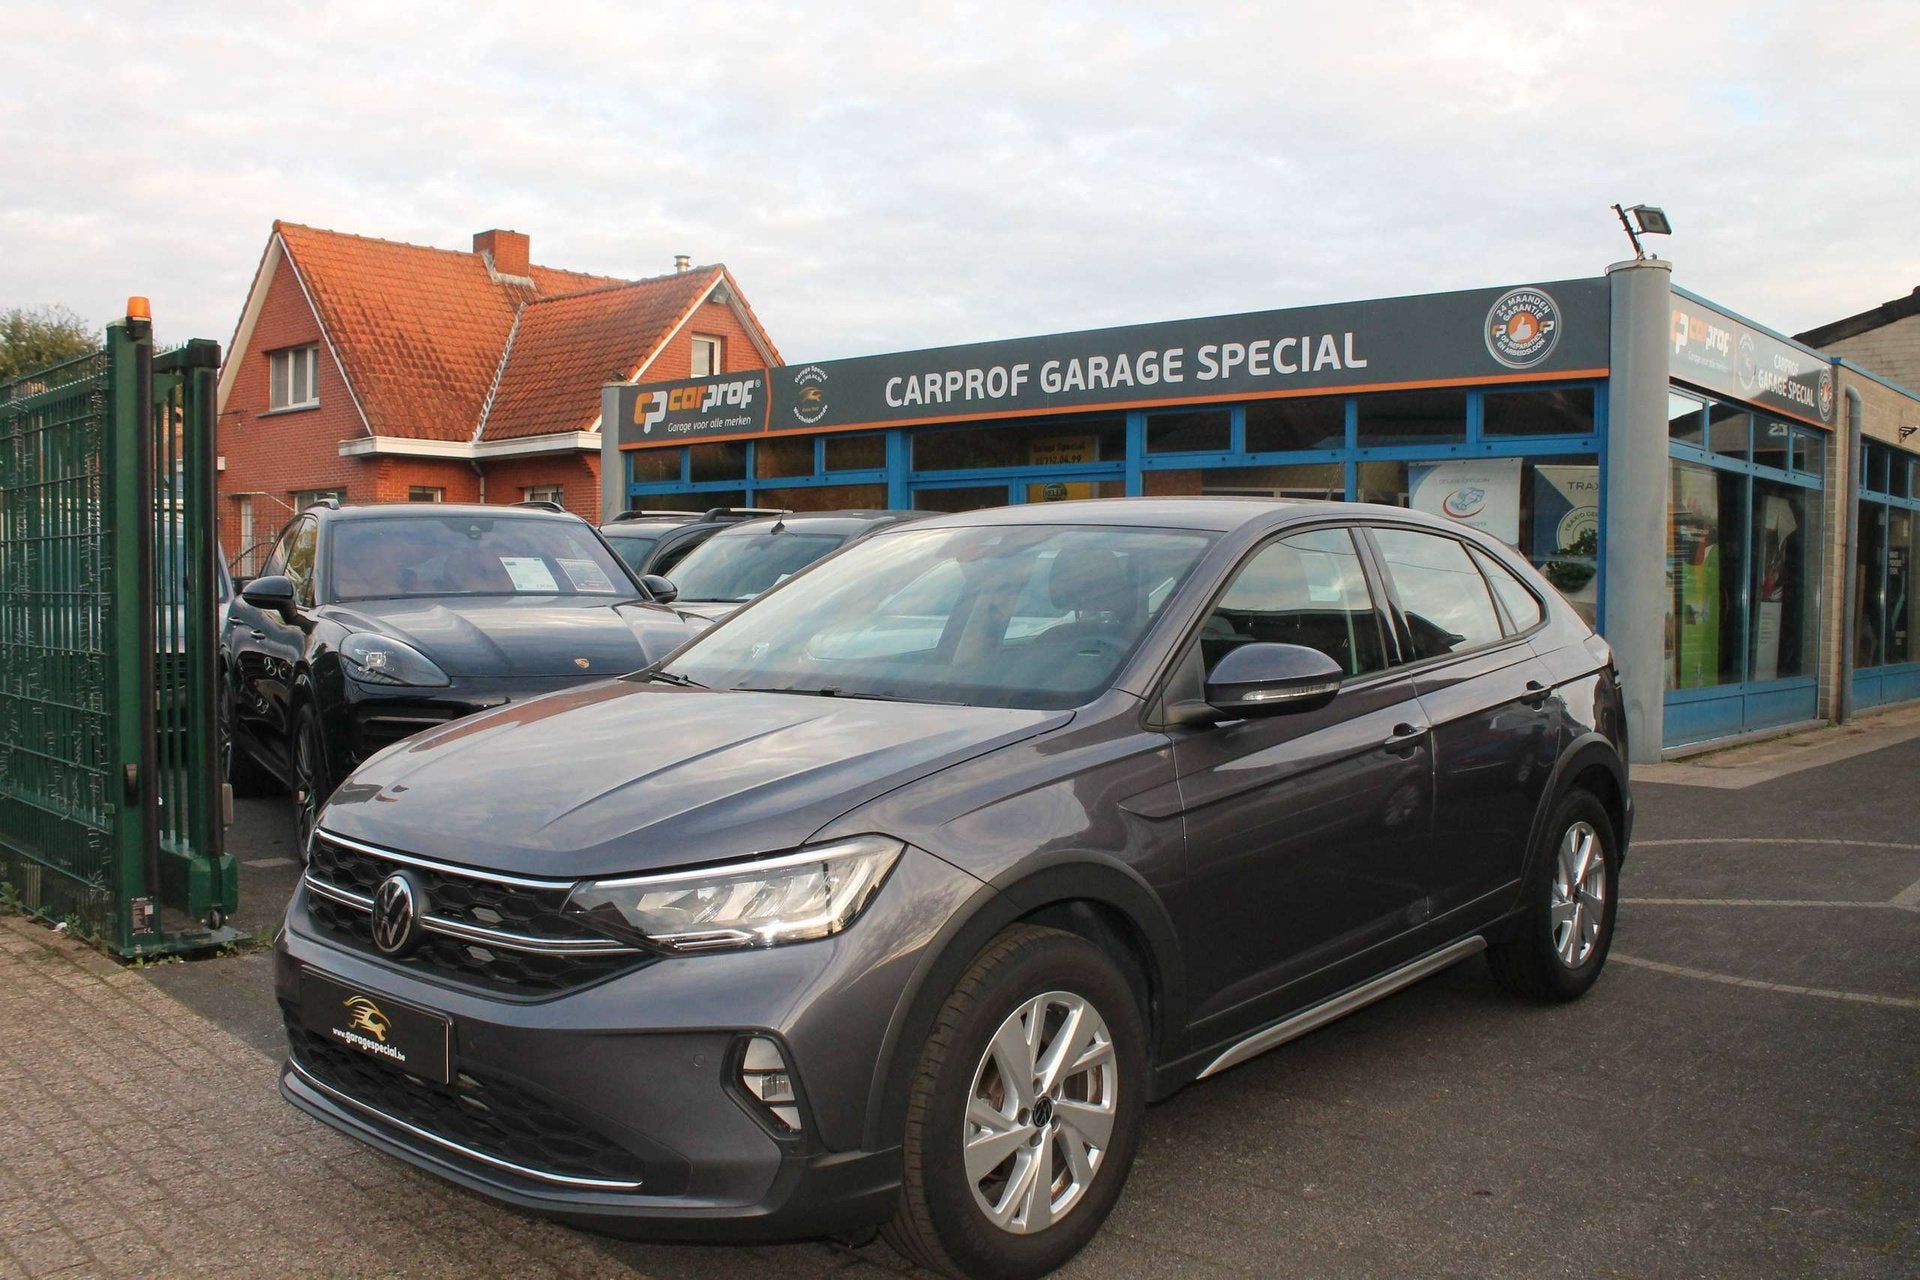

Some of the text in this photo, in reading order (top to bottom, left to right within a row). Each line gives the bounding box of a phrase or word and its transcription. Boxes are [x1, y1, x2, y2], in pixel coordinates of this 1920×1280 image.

[1496, 294, 1551, 317] 24 MAANDEN
[1503, 303, 1544, 322] GARANTIE
[885, 331, 1368, 408] CARPROF GARAGE SPECIAL
[1758, 369, 1788, 398] GARAGE
[1788, 380, 1815, 407] SPECIAL
[667, 415, 752, 433] Garage voor alle merken
[332, 1027, 406, 1062] www.garagespecial.be
